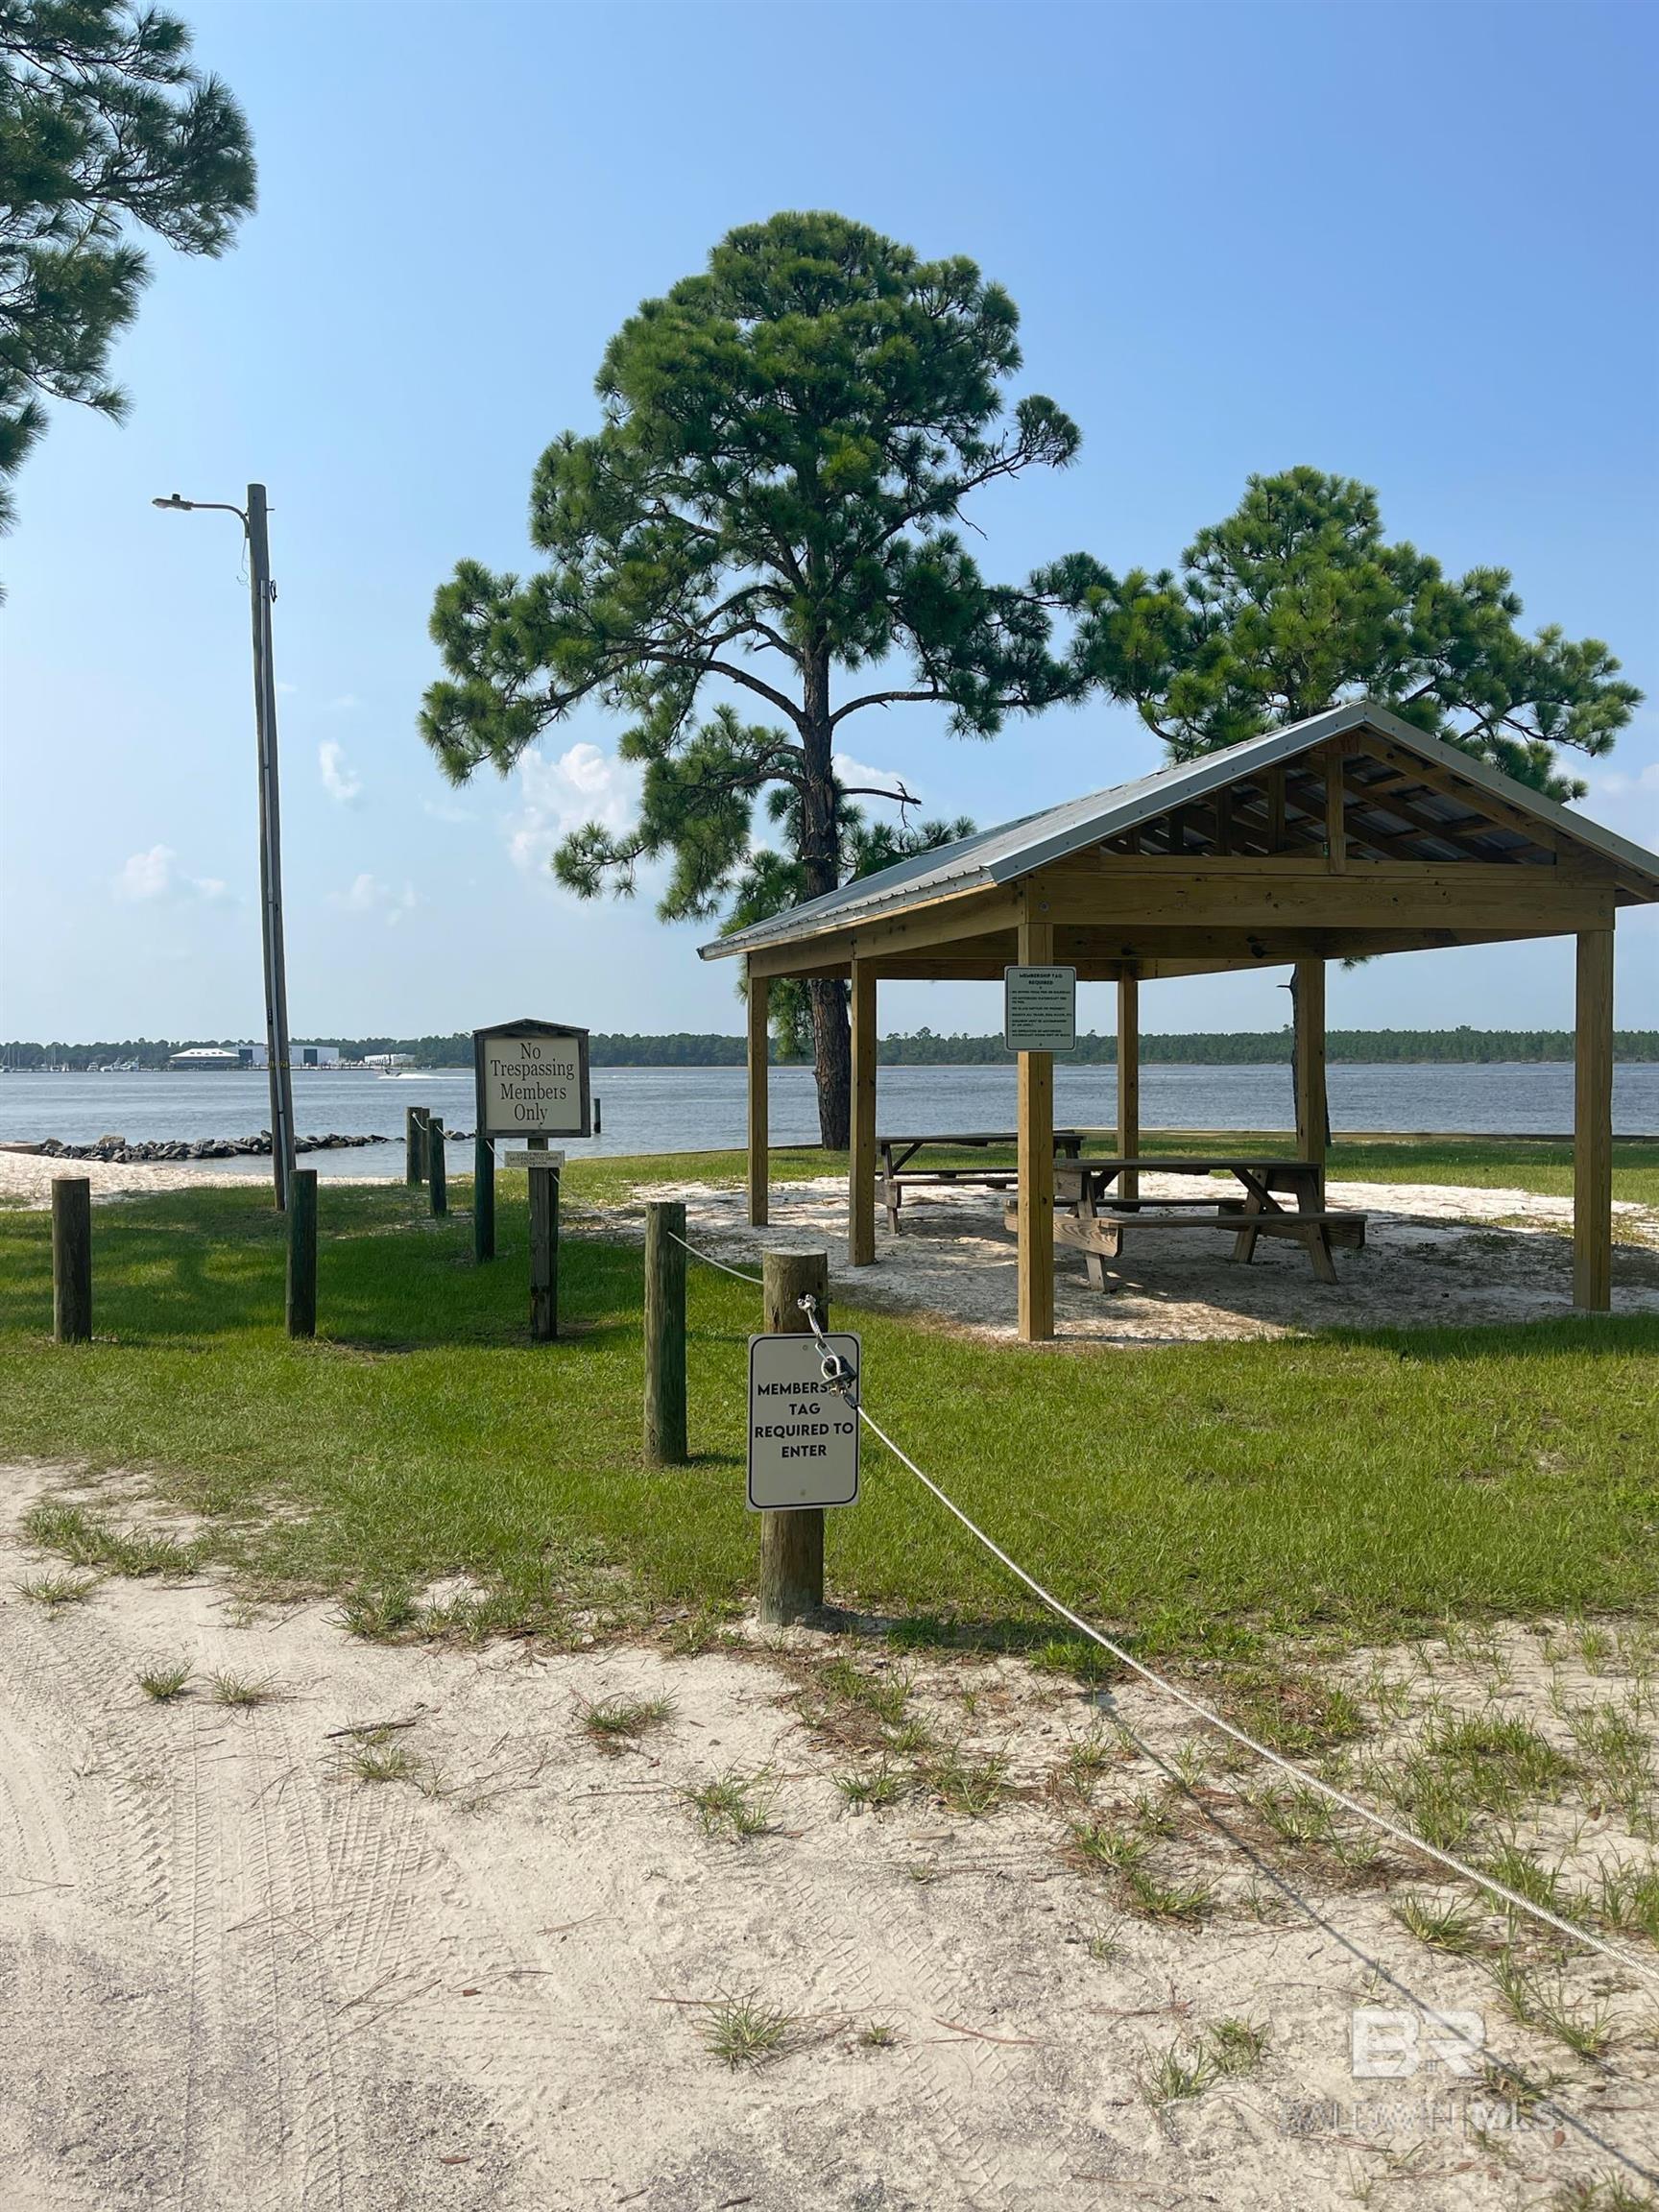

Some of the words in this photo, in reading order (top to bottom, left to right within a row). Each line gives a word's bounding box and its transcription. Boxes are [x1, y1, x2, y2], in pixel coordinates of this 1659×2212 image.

[519, 1043, 541, 1060] No
[490, 1058, 575, 1081] Trespassing
[500, 1082, 567, 1100] Members
[514, 1102, 548, 1125] Only
[757, 1382, 853, 1396] MEMBERS
[788, 1402, 821, 1416] TAG
[755, 1423, 830, 1439] REQUIRED
[833, 1422, 854, 1435] TO
[781, 1444, 827, 1459] ENTER
